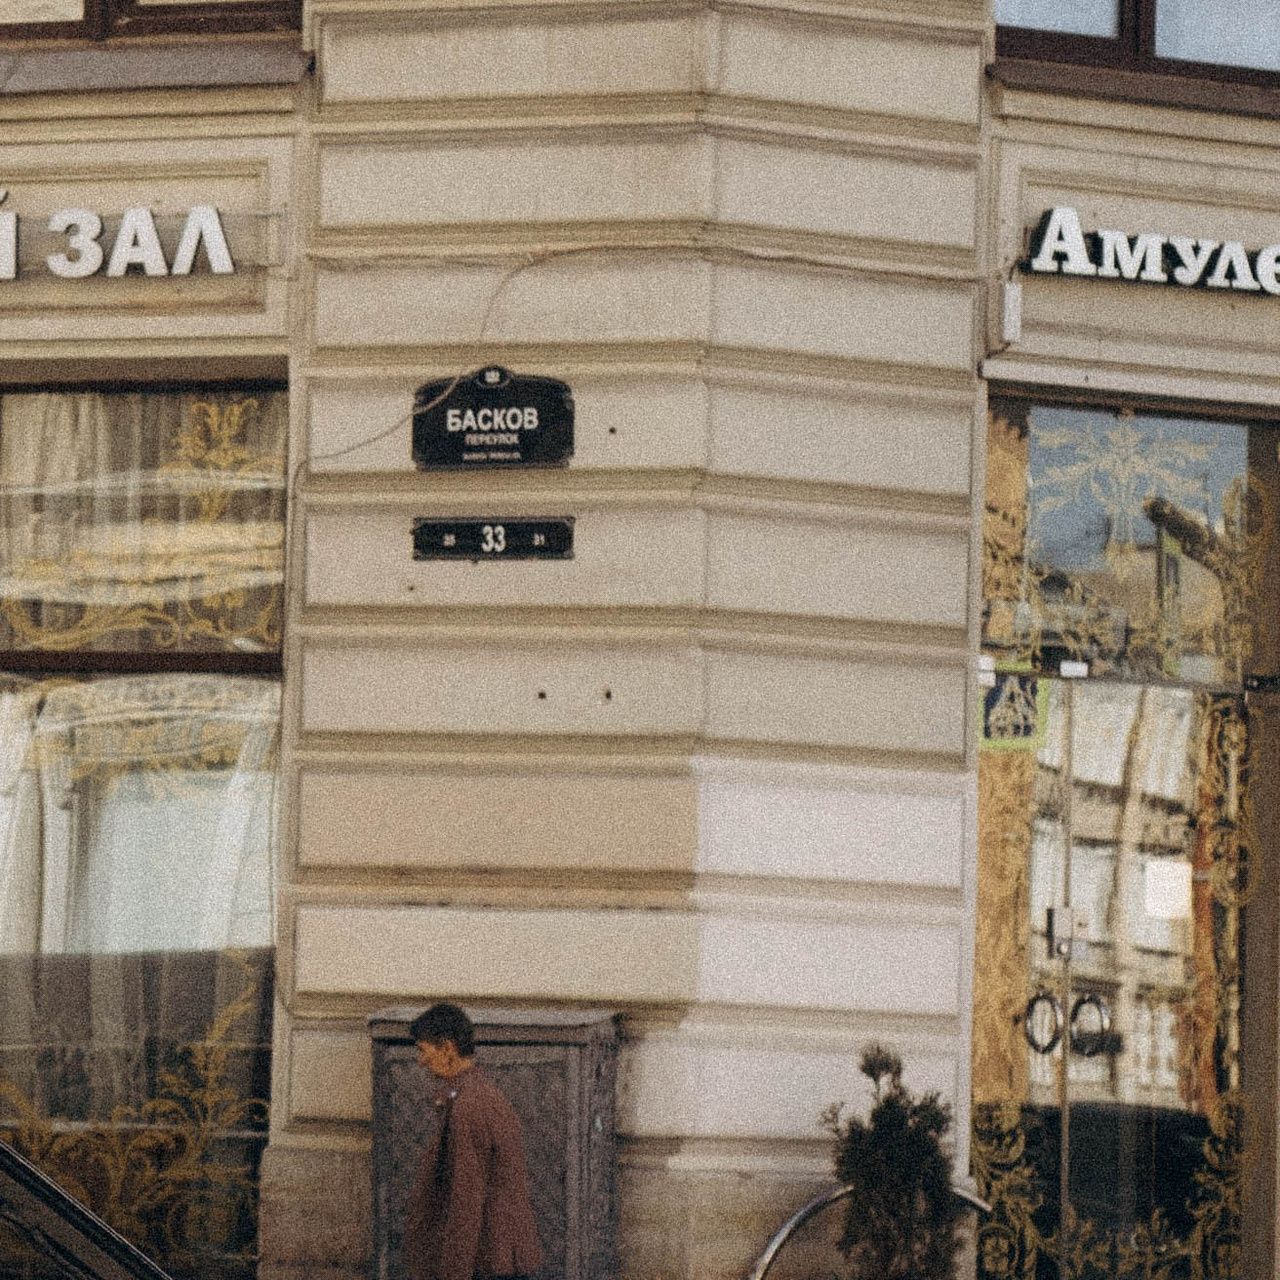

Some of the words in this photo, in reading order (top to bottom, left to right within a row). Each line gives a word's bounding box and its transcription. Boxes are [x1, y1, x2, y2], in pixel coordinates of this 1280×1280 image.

[48, 200, 234, 278] ЗАЛ
[447, 407, 538, 431] БАСКОВ
[482, 526, 506, 552] 33
